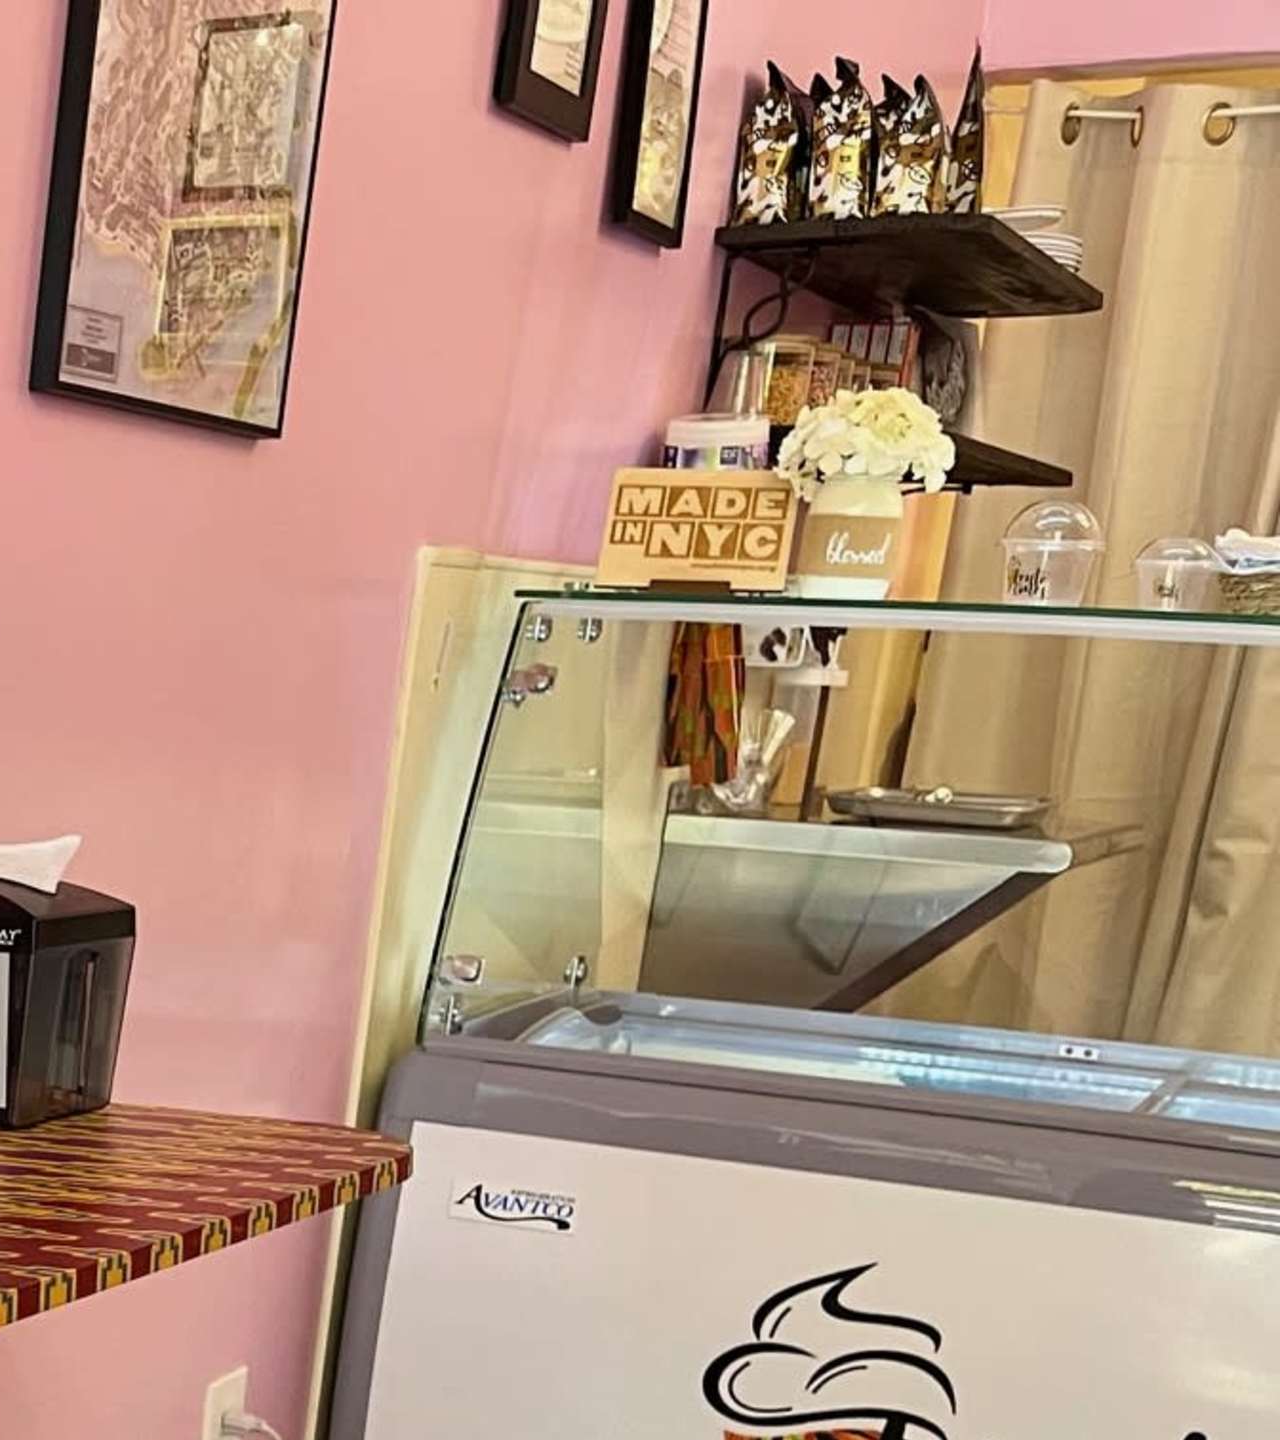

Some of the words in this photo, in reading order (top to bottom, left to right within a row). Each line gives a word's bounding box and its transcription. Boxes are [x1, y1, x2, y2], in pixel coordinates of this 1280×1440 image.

[617, 486, 787, 519] MADE
[612, 520, 642, 544] IN
[646, 521, 779, 558] NYC
[454, 1183, 575, 1222] AVANTCO
